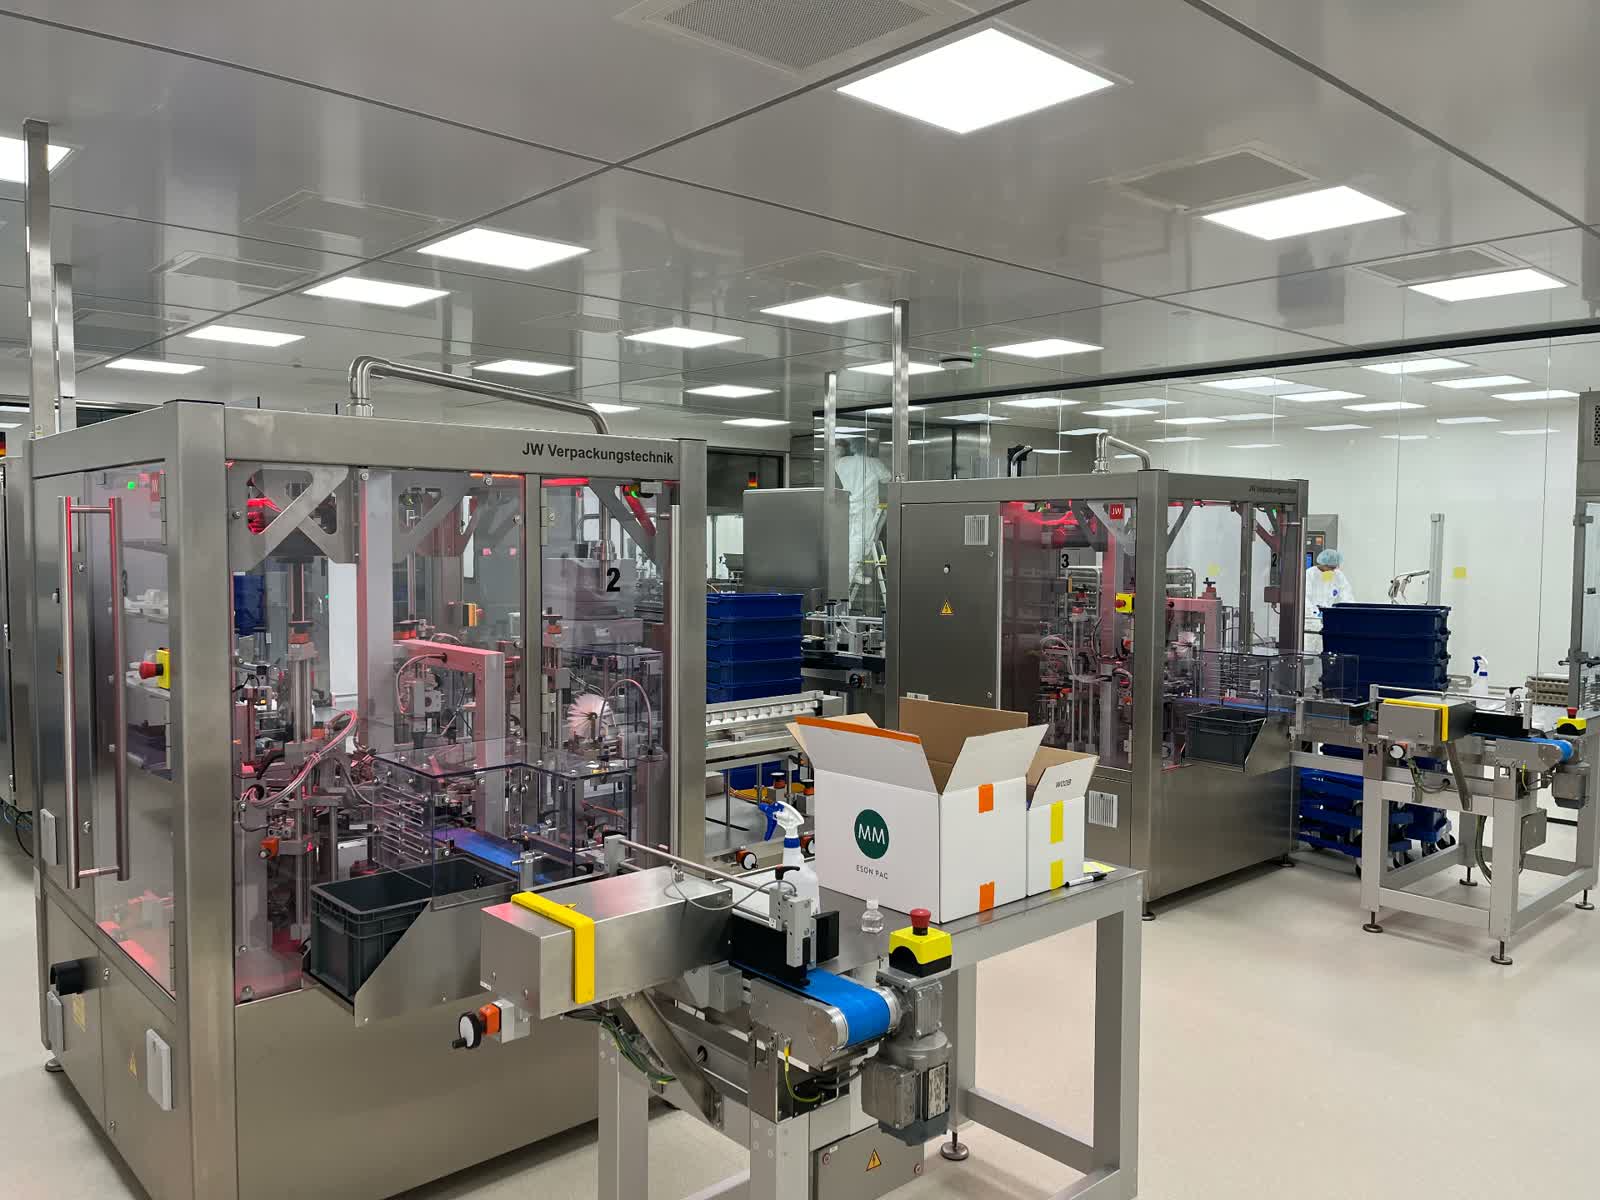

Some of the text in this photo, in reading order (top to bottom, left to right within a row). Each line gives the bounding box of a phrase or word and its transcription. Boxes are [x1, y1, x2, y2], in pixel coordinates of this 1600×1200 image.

[522, 442, 674, 464] JW Verpackungstechnik
[1111, 506, 1122, 515] JW
[1061, 553, 1070, 568] 3
[606, 567, 621, 592] 2
[858, 823, 886, 845] MM
[856, 864, 874, 876] ESON
